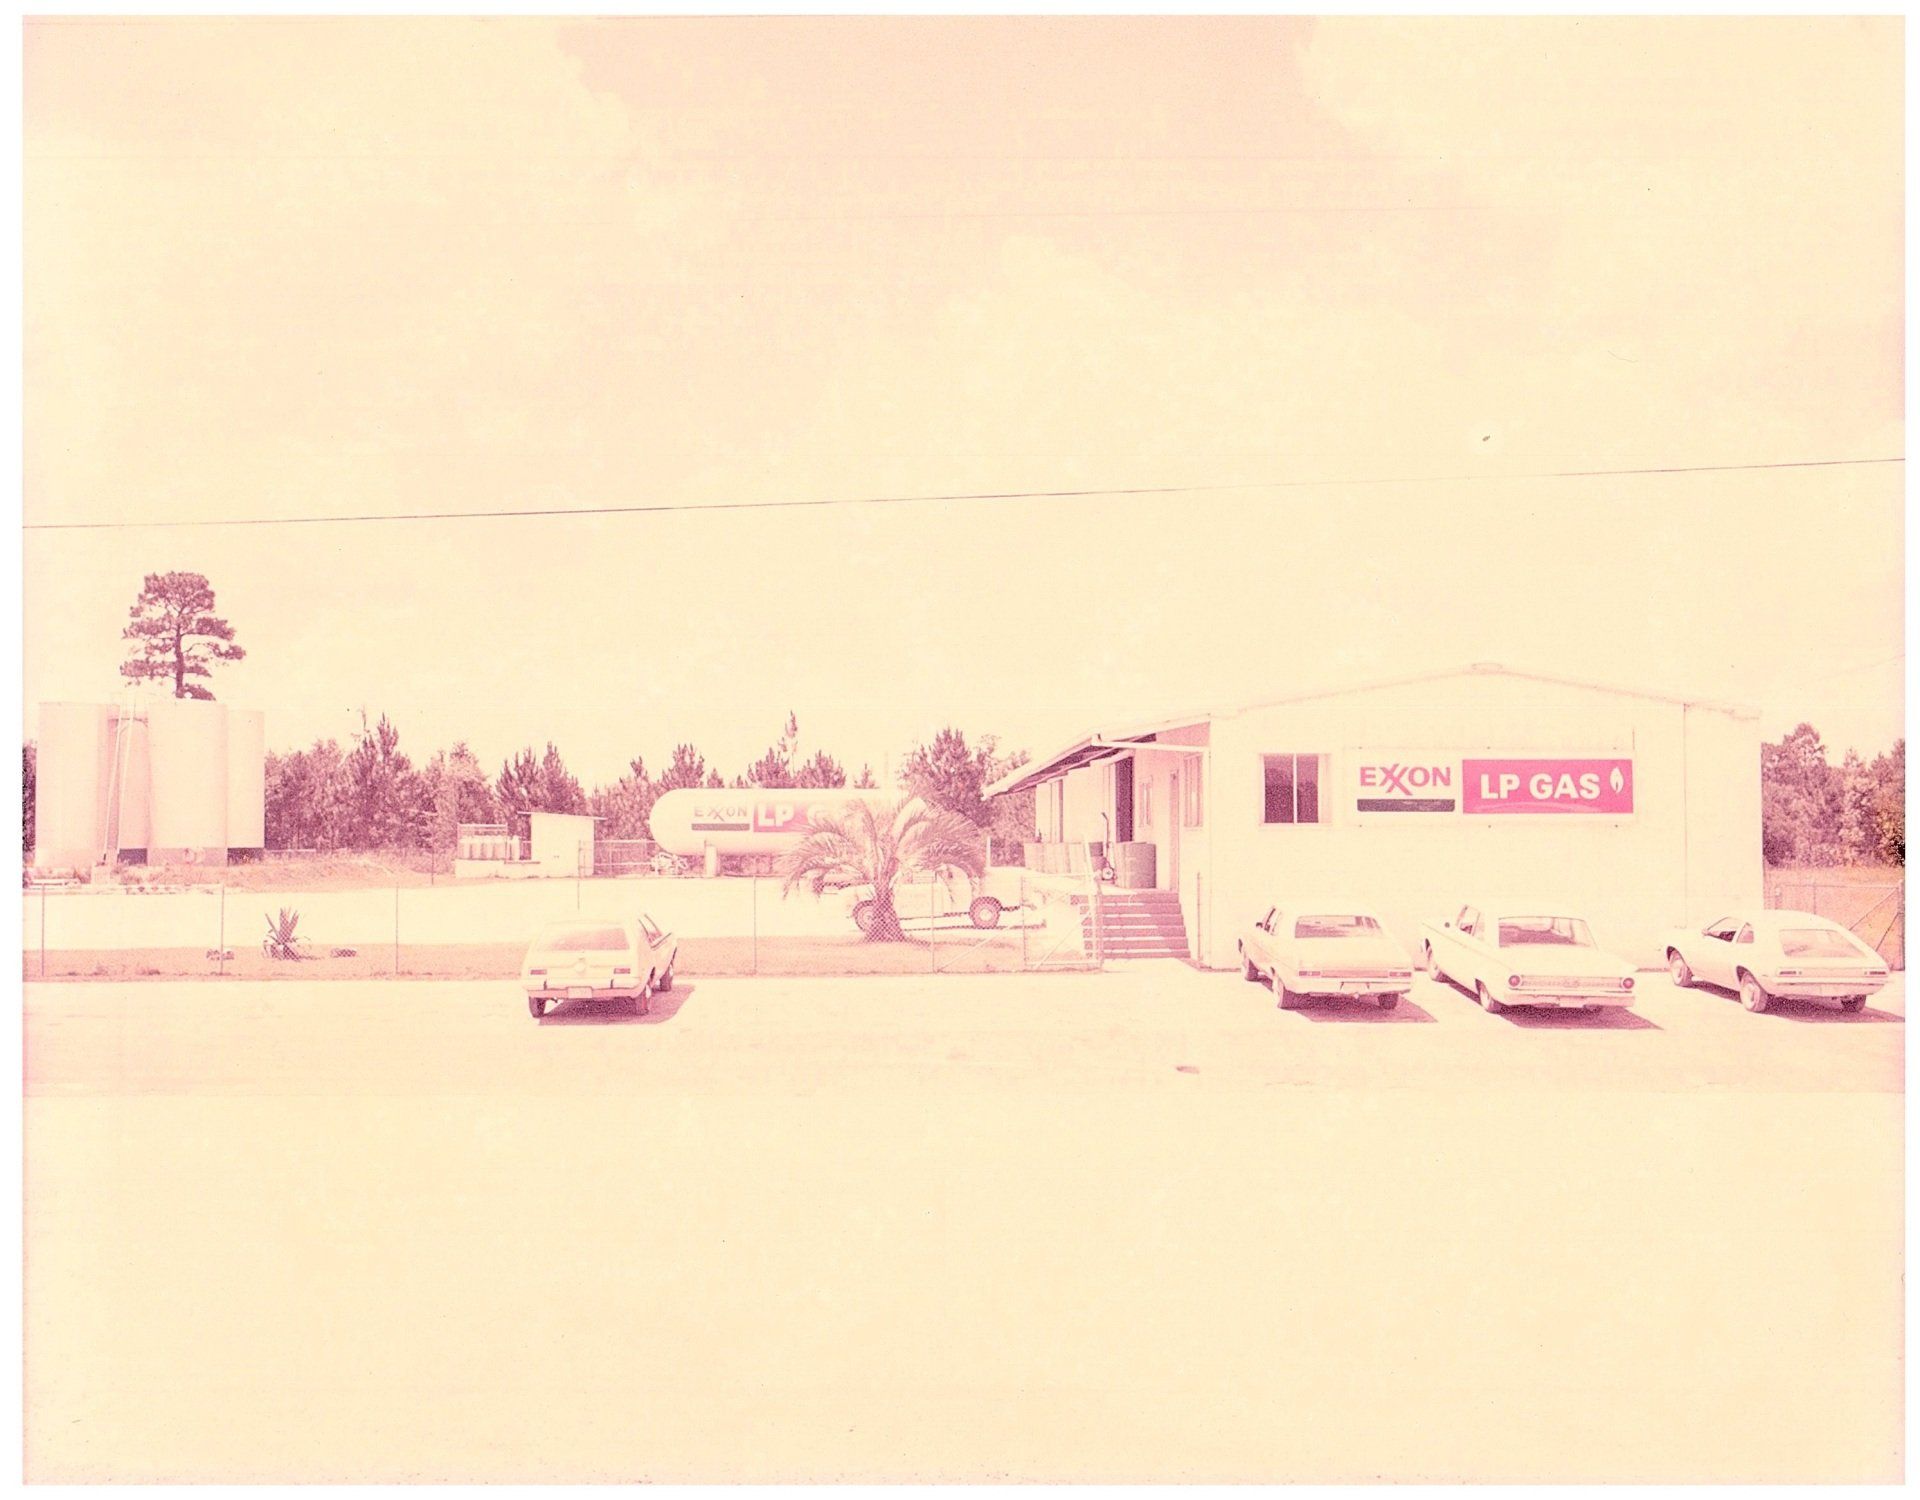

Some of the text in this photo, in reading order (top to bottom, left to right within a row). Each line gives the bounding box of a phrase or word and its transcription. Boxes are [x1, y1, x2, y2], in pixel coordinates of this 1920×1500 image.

[1360, 763, 1451, 796] EXXON
[1480, 773, 1601, 800] LP GAS
[694, 805, 748, 821] EXXON
[757, 803, 795, 827] LP
